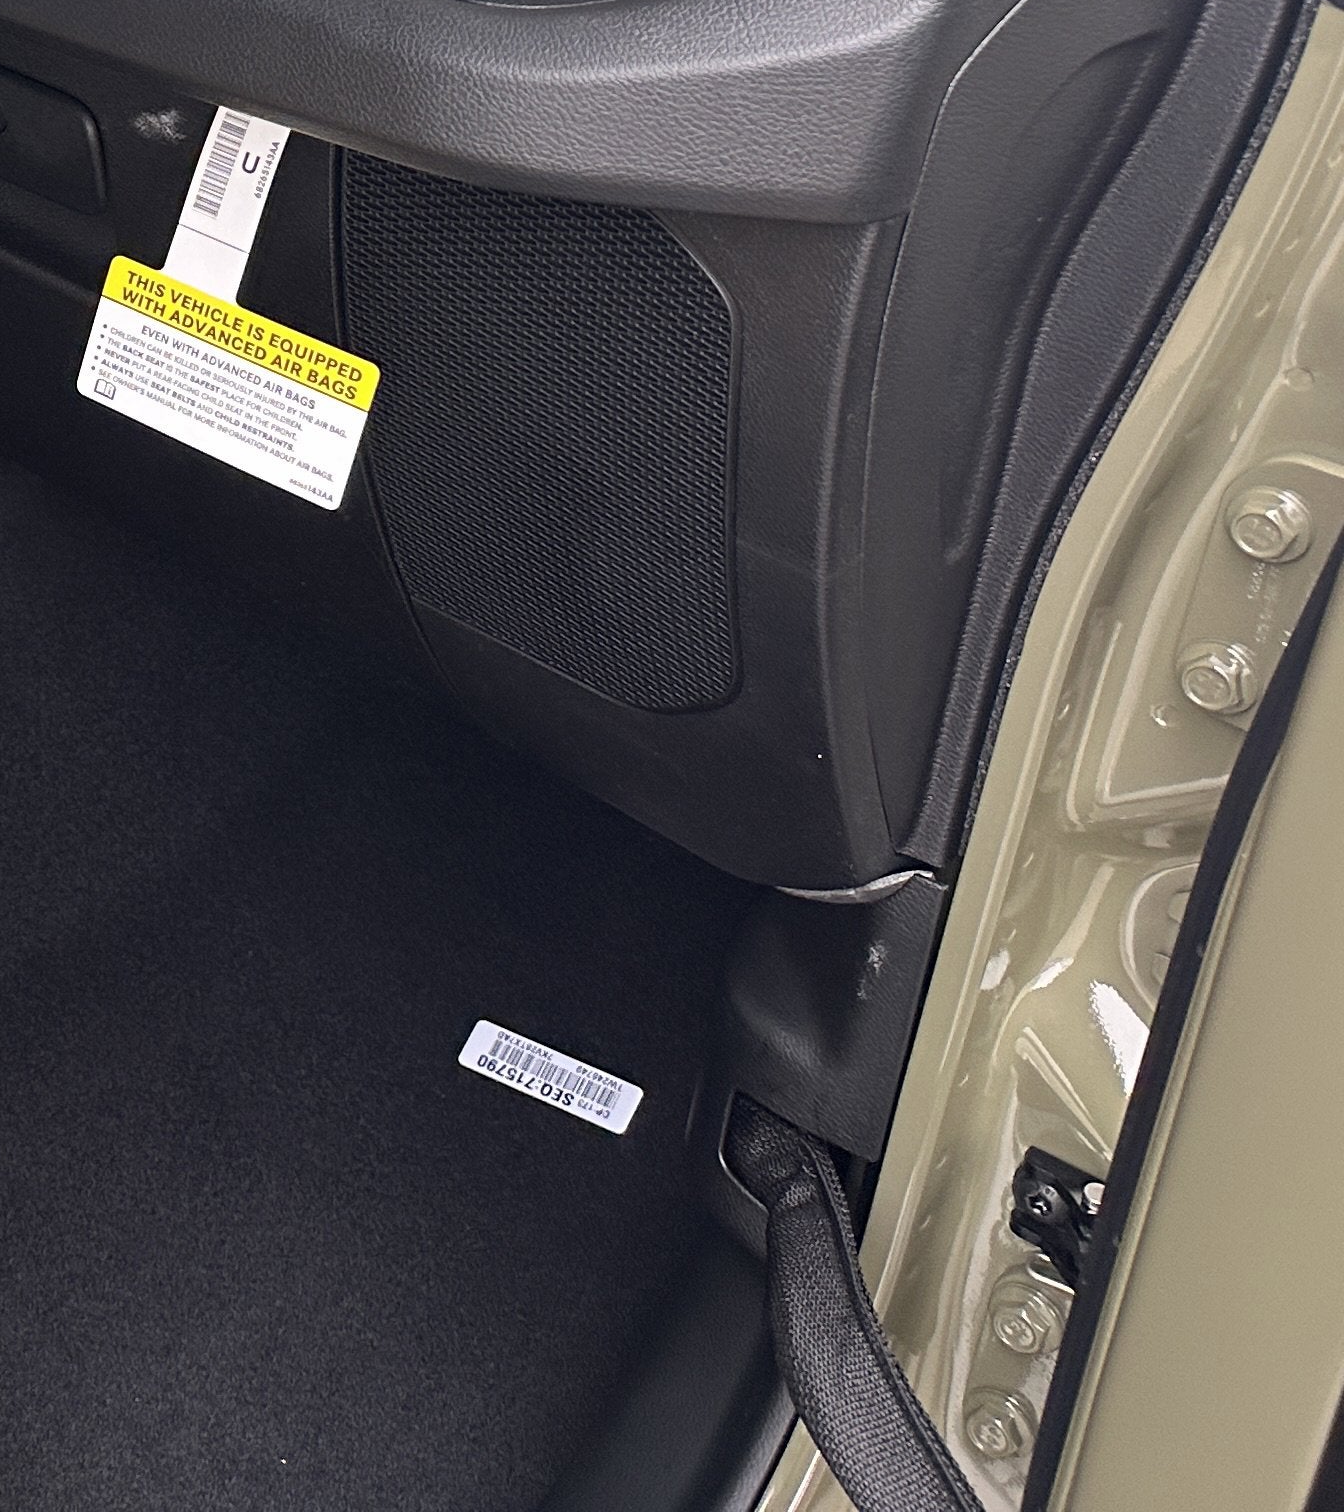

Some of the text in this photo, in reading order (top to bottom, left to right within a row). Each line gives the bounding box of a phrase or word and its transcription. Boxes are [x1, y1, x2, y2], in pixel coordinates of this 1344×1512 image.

[241, 151, 262, 175] U
[120, 286, 358, 401] WITH ADVANCED AIR BAGS
[125, 270, 363, 384] THIS VEHICLE IS EQUIPPED
[140, 324, 316, 410] EVEN WITH ADVANCED AIR BAGS
[100, 357, 134, 379] ALWAYS
[134, 373, 149, 386] USE
[149, 380, 171, 396] SEAT
[170, 390, 196, 407] BELTS
[196, 401, 213, 415] AND
[213, 409, 240, 427] CHILD
[103, 347, 130, 365] NEVER
[131, 360, 146, 372] PUT
[152, 369, 200, 397] REAR-FACING
[200, 391, 224, 408] CHILD
[224, 402, 243, 416] SEAT
[253, 415, 269, 428] THE
[106, 336, 121, 349] THE
[121, 343, 143, 359] BACK
[144, 354, 164, 369] SEAT
[173, 367, 189, 380] THE
[189, 374, 220, 394] SAFEST
[220, 388, 245, 405] PLACE
[245, 399, 261, 412] FOR
[109, 326, 146, 348] CHILDREN
[146, 342, 162, 355] CAN
[173, 355, 199, 372] KILLED
[200, 367, 211, 378] OR
[212, 372, 252, 396] SERIOUSLY
[297, 410, 314, 424] THE
[313, 418, 328, 430] AIR
[97, 368, 111, 380] SEE
[145, 390, 177, 410] MANUAL
[177, 404, 193, 418] FOR
[193, 412, 216, 428] MORE
[269, 446, 295, 465] ABOUT
[295, 459, 310, 472] AIR
